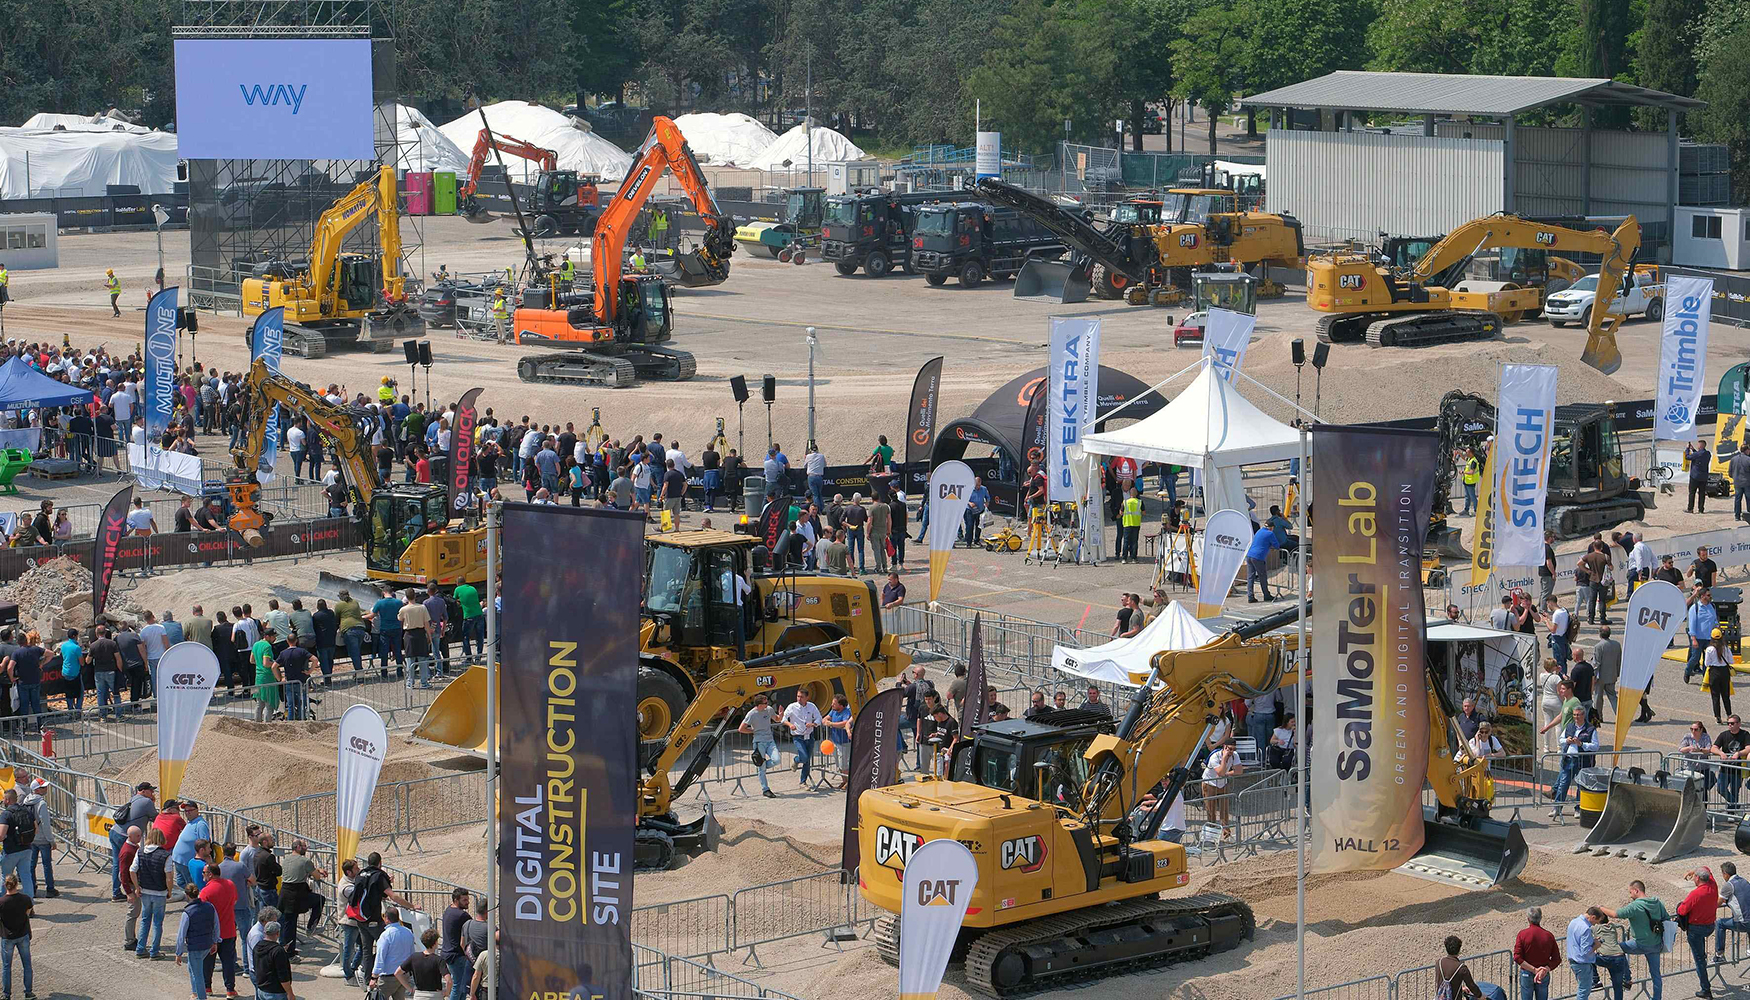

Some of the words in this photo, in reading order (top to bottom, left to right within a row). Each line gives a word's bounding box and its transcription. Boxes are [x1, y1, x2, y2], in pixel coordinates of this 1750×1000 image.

[627, 168, 650, 200] DEVELON
[342, 199, 366, 220] KOMATSU
[1180, 234, 1195, 247] CAT
[1536, 232, 1554, 244] CAT
[1340, 274, 1360, 289] CAT
[1669, 296, 1700, 396] Trimble
[71, 397, 83, 405] CSF
[318, 432, 330, 446] icon
[455, 405, 475, 489] OILQUICK
[1512, 408, 1544, 528] SITECH
[938, 483, 965, 500] CAT
[1337, 481, 1378, 566] Lab
[1216, 534, 1234, 546] CGT
[1399, 483, 1412, 591] TRANSITION
[1707, 547, 1722, 555] TECH
[1507, 577, 1534, 589] Trimble
[806, 597, 818, 605] 966
[1638, 607, 1671, 631] CAT
[1397, 602, 1409, 672] DIGITAL
[172, 674, 195, 685] CGT
[756, 676, 772, 686] CAT
[1336, 573, 1376, 782] SaMoTer
[1396, 683, 1407, 718] AND
[350, 736, 369, 752] CGT
[1394, 728, 1404, 785] GREEN
[546, 640, 578, 922] CONSTRUCTION
[515, 784, 542, 921] DIGITAL
[877, 826, 917, 866] CAT
[1001, 836, 1037, 870] CAT
[1334, 837, 1378, 852] HALL
[1383, 838, 1400, 851] 12
[593, 850, 621, 926] SITE
[918, 880, 960, 906] CAT
